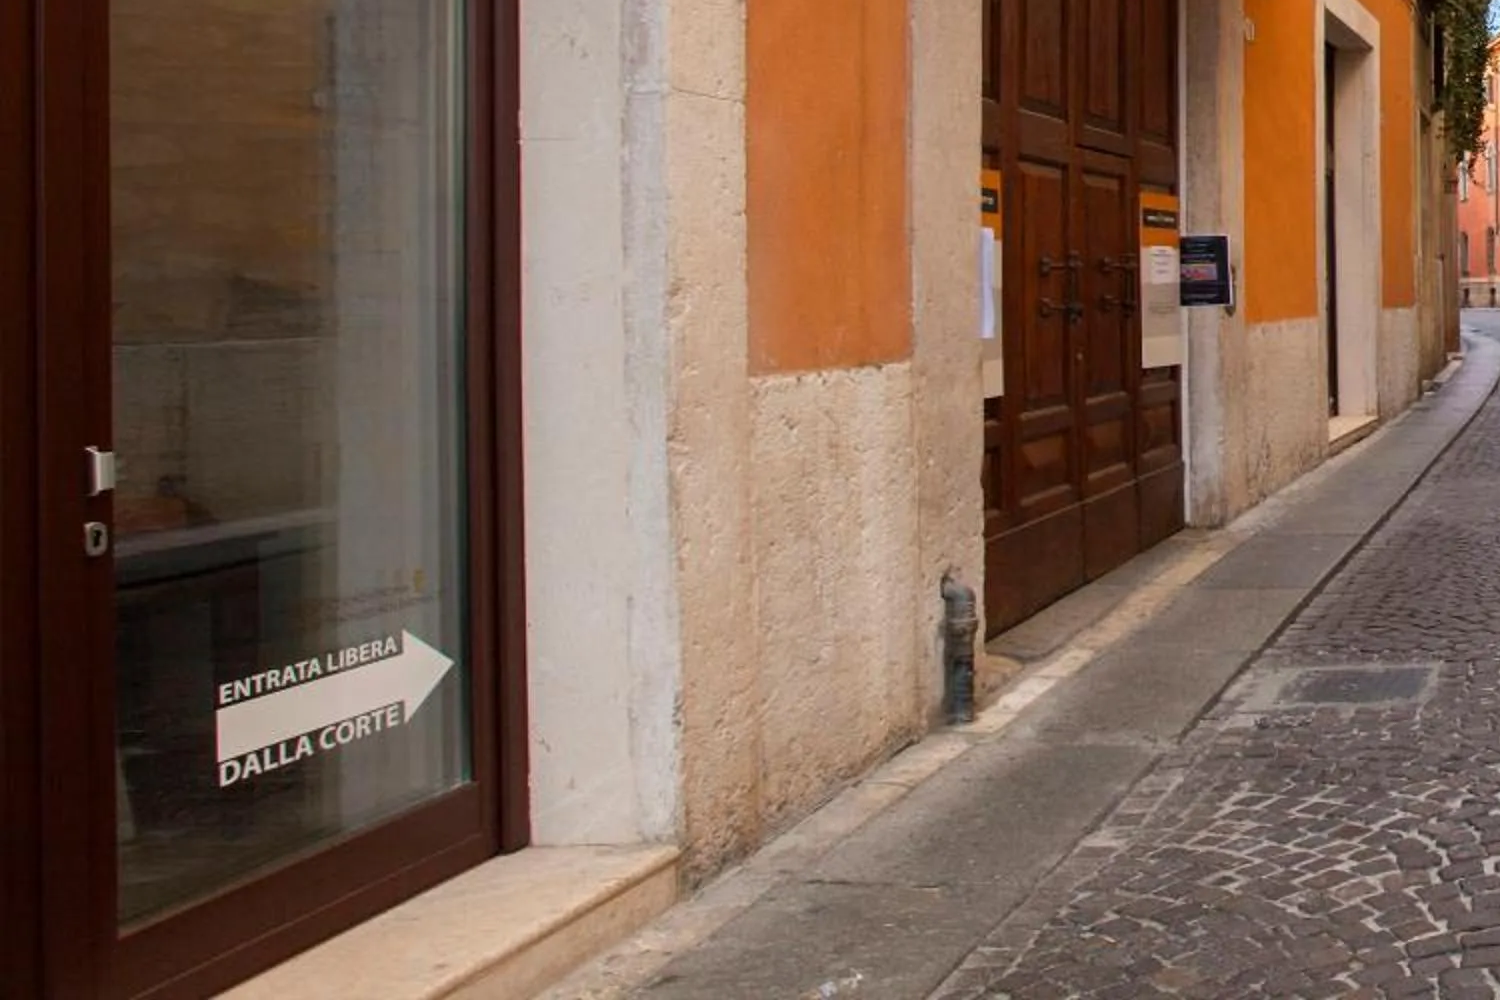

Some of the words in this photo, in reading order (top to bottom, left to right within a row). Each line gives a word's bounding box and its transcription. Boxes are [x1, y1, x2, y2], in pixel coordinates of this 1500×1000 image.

[218, 657, 322, 704] ENTRATA
[327, 635, 398, 674] LIBERA
[218, 735, 314, 788] DALLA
[319, 703, 401, 751] CORTE
